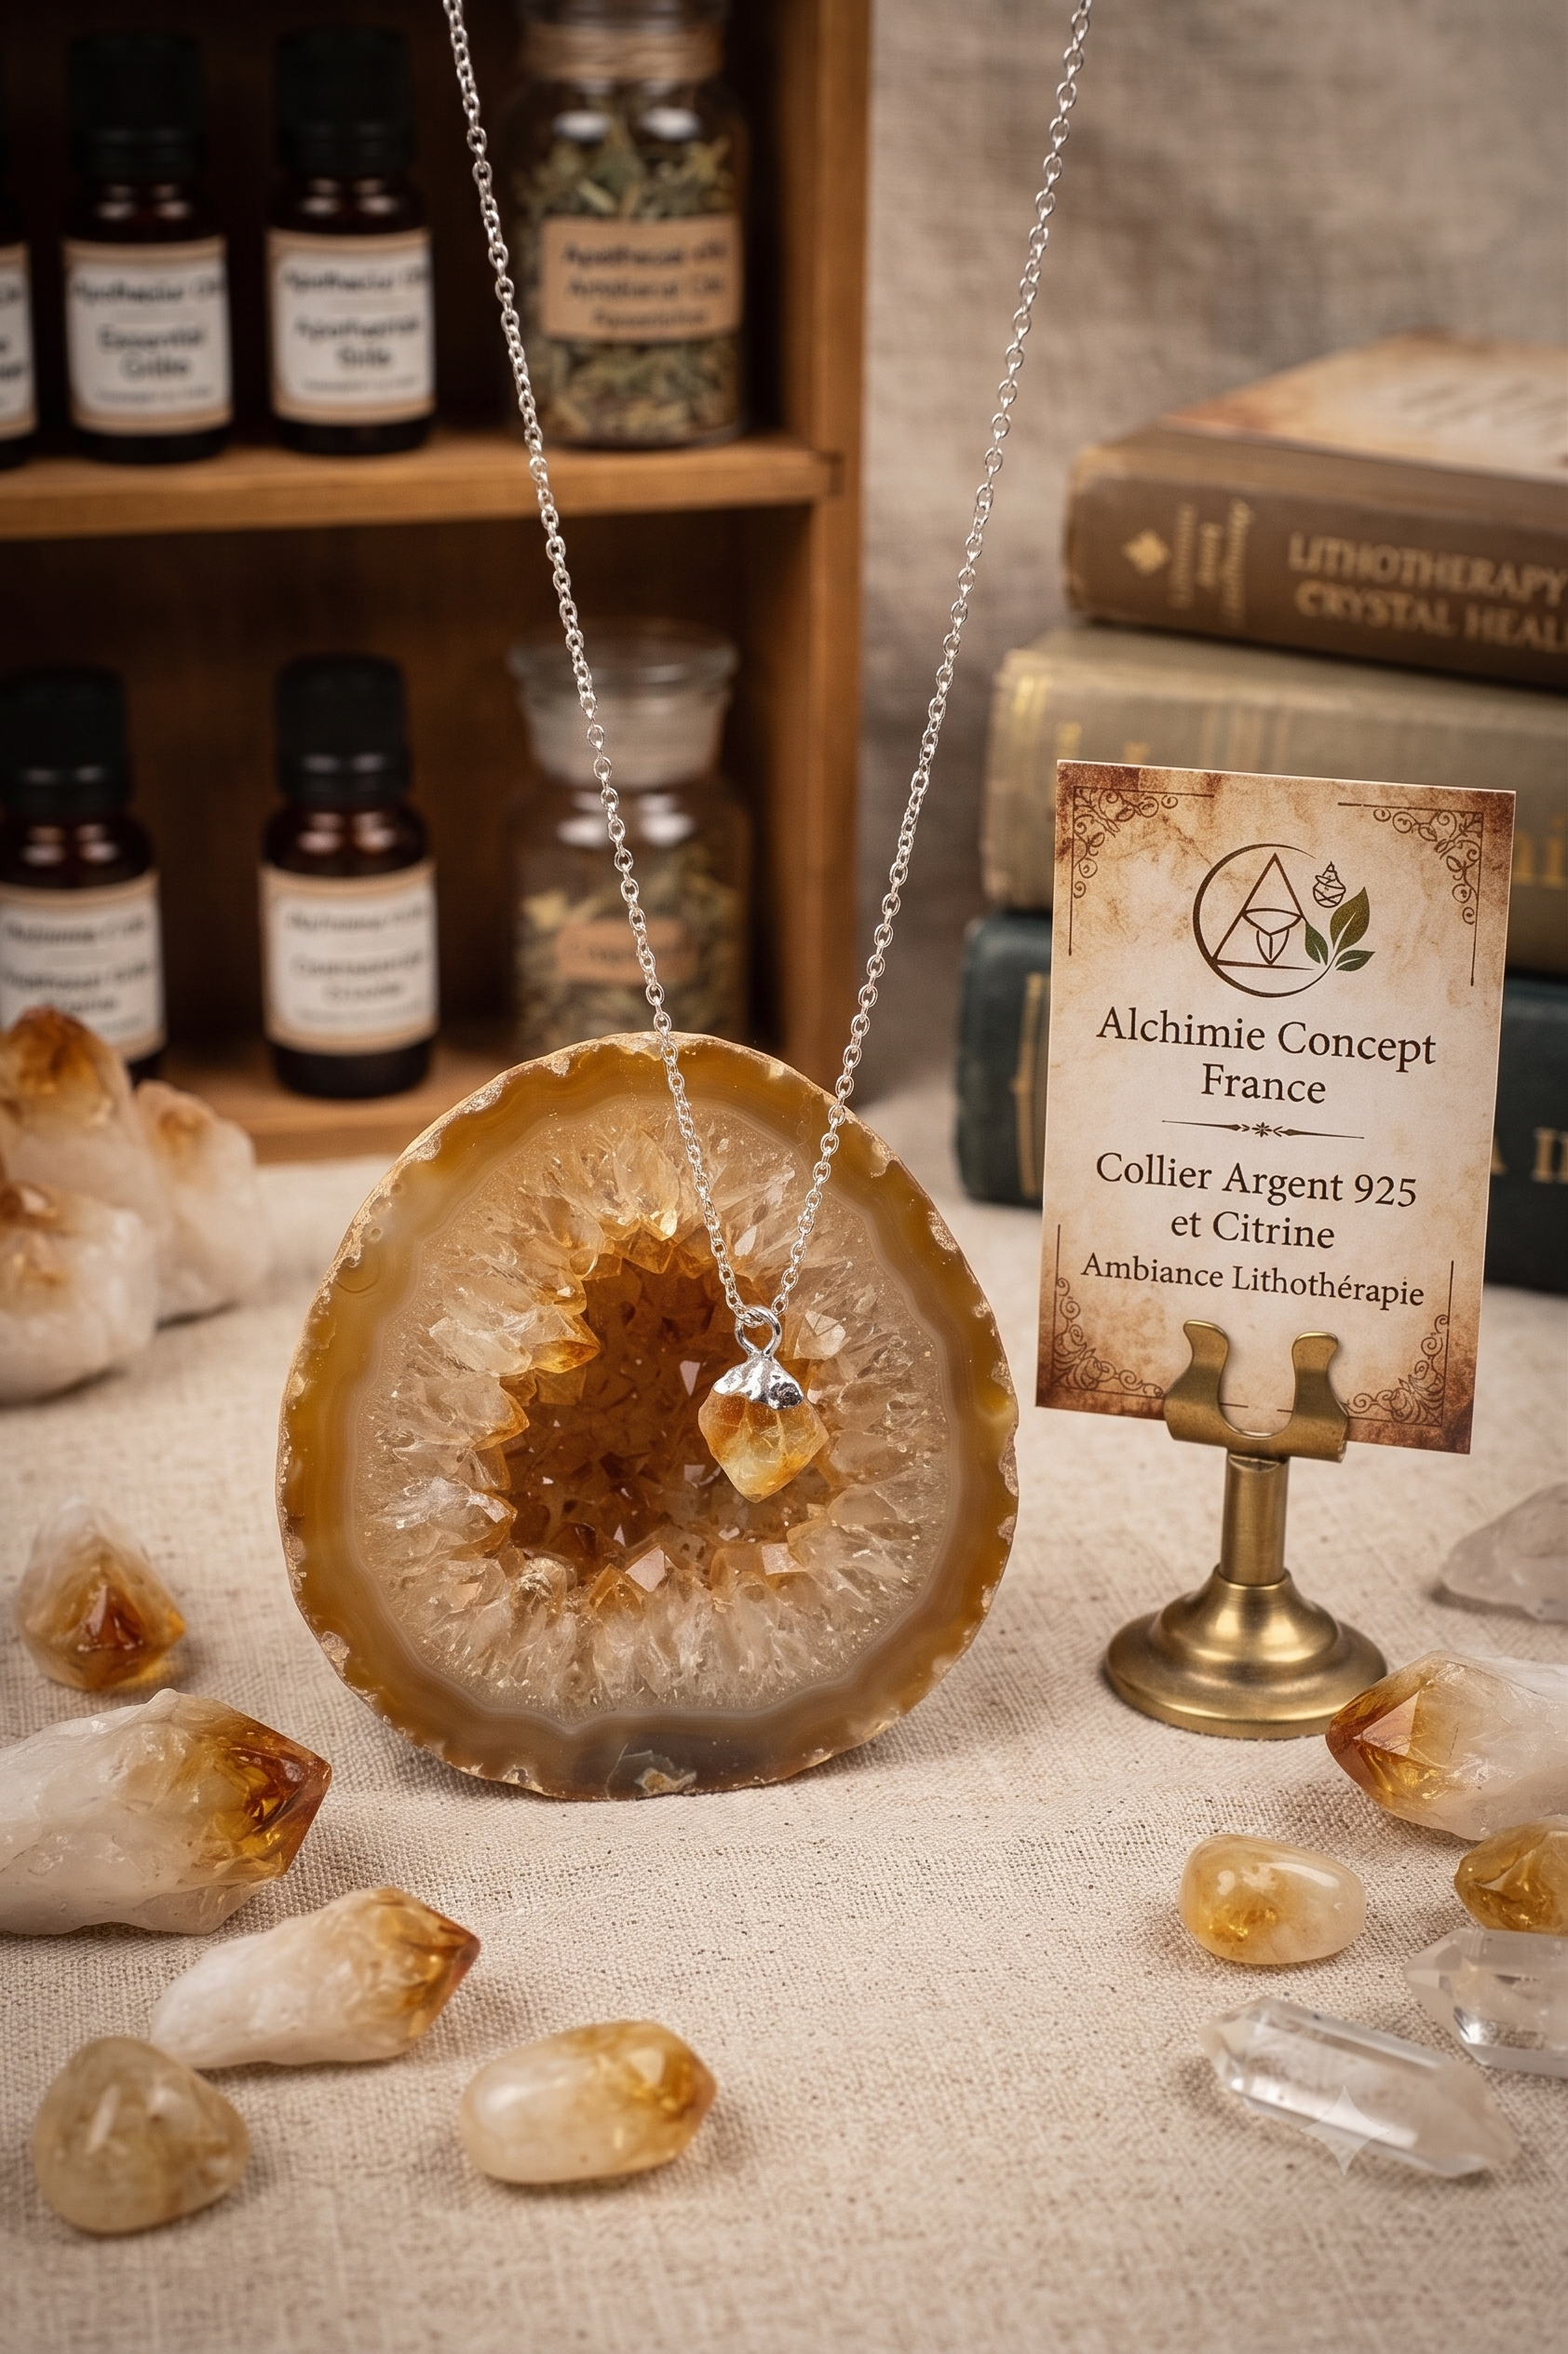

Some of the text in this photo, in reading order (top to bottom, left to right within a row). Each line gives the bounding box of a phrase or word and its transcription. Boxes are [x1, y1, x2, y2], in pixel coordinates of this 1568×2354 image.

[1295, 579, 1568, 653] CRYSTAL HEAL
[1095, 1006, 1437, 1074] Alchimie Concept
[1200, 1062, 1326, 1104] France
[1096, 1152, 1417, 1208] Collier Argent 925
[1170, 1211, 1335, 1250] et Citrine
[1080, 1252, 1425, 1311] Ambiance Lithothérapie
